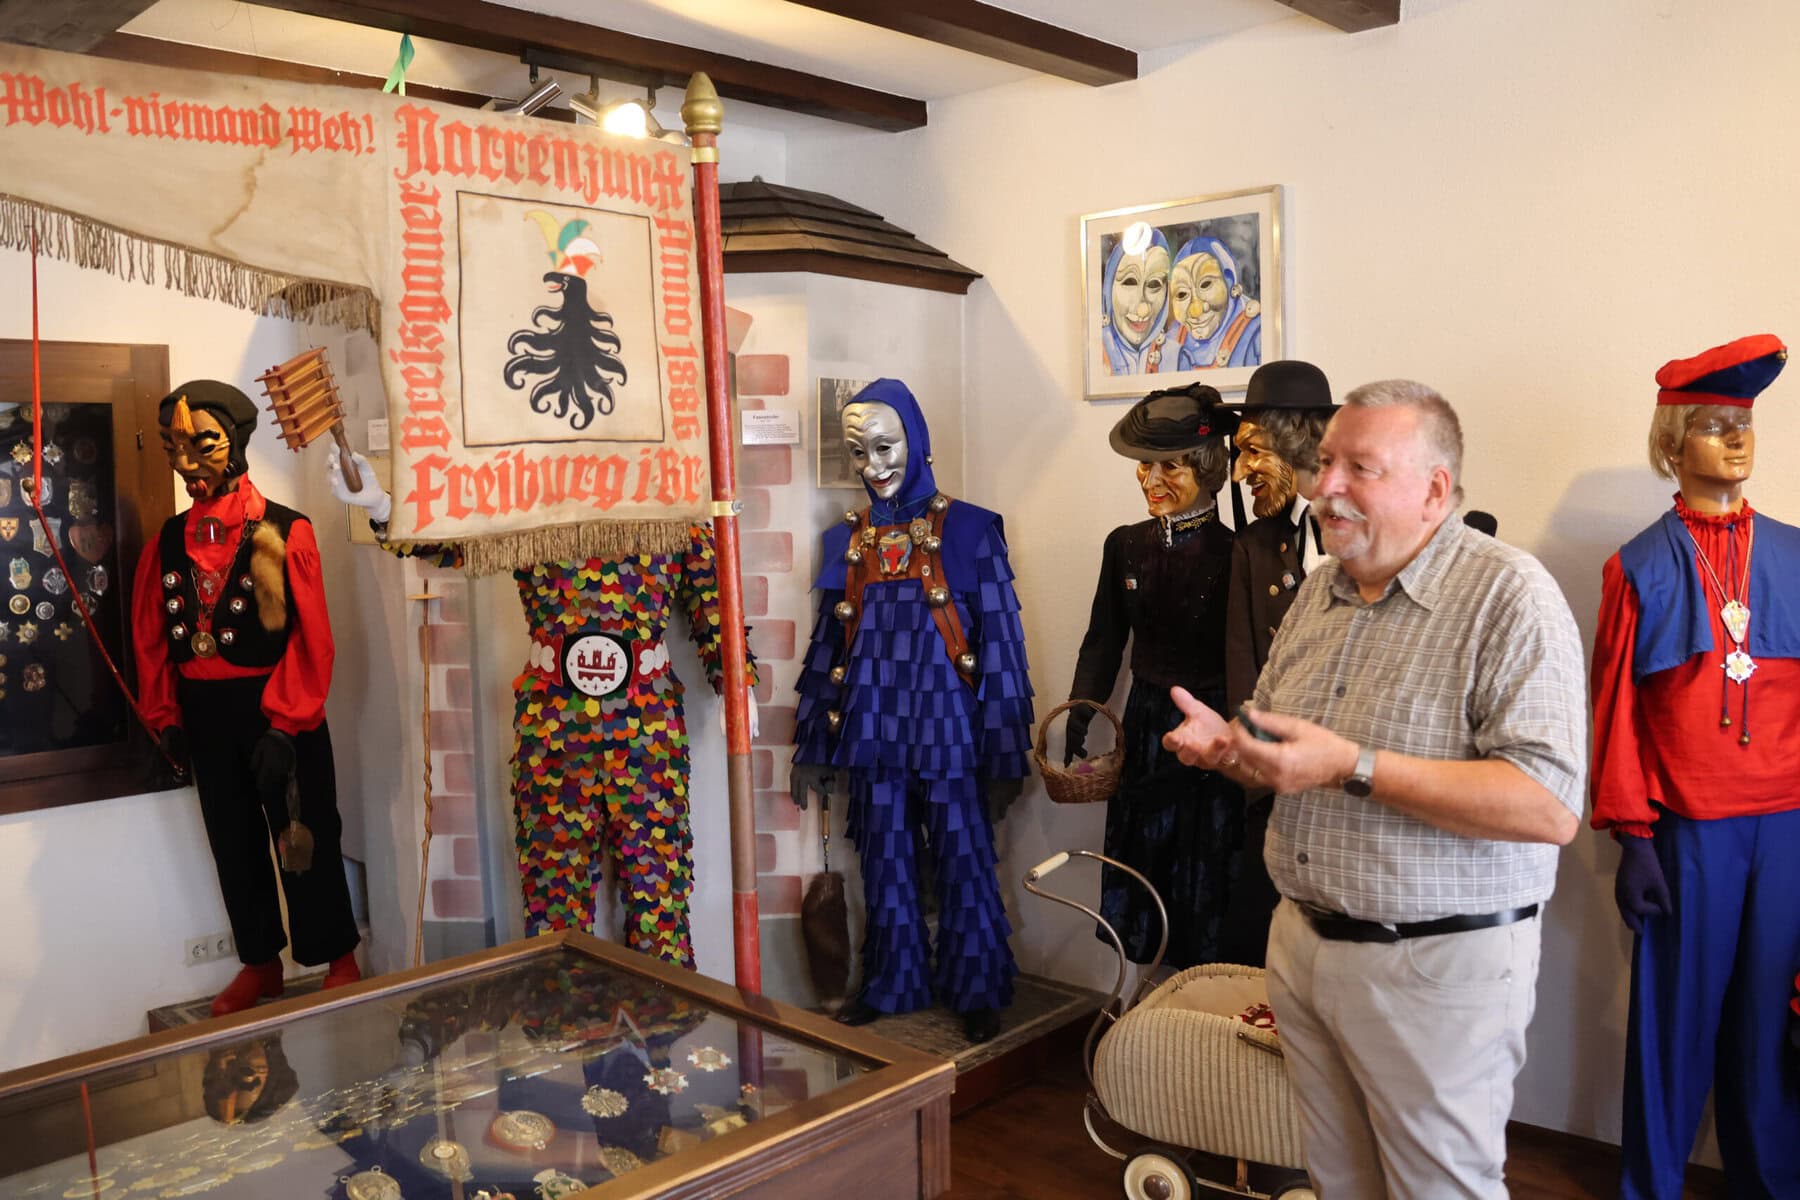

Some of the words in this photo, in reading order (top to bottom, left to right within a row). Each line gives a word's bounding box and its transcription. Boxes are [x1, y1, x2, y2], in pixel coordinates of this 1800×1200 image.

[394, 102, 685, 212] Narrenzunft
[389, 181, 453, 453] Breisgauer
[652, 213, 693, 336] Anno
[660, 341, 701, 441] 1886
[403, 448, 629, 534] Freiburg
